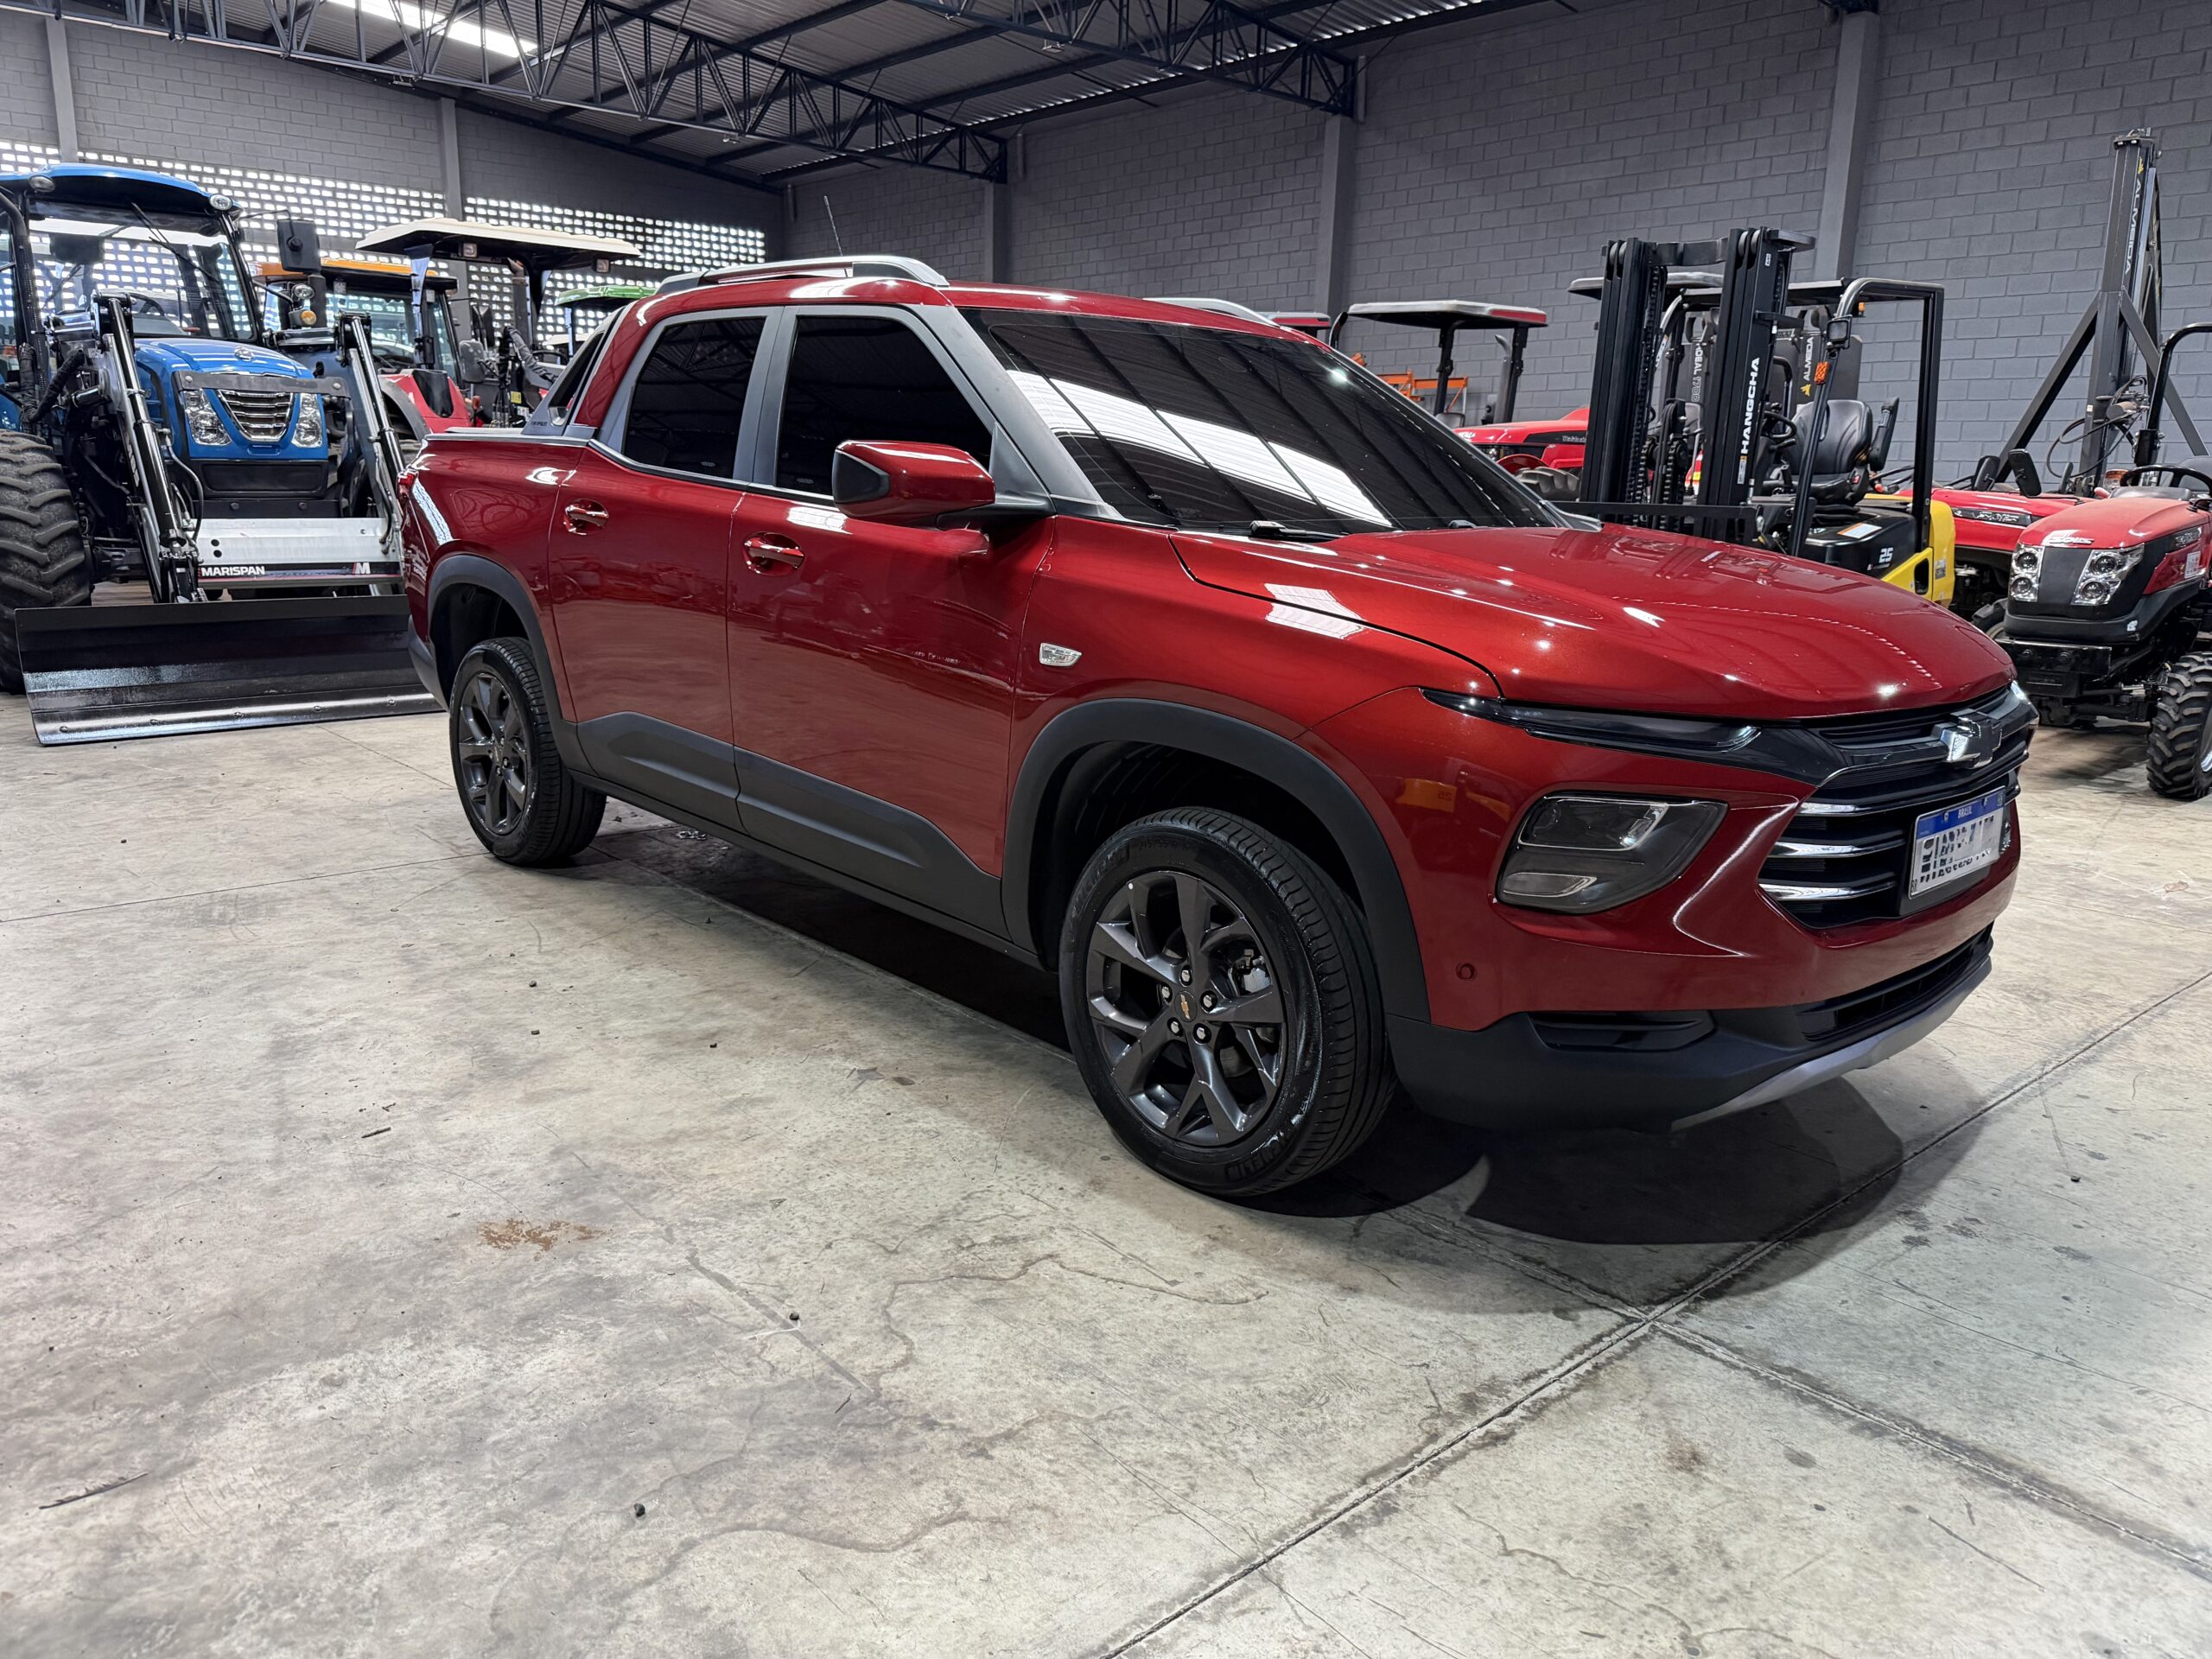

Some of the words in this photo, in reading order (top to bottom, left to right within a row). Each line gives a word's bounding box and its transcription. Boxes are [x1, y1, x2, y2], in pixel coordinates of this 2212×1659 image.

[2125, 179, 2142, 275] ALMEIDA
[1803, 336, 1815, 381] ALMEIDA
[1692, 376, 1702, 402] 1700
[1741, 357, 1760, 454] HANGCHA
[1878, 547, 1893, 563] 25
[200, 565, 265, 576] MARISPAN
[1958, 805, 1972, 818] BRASIL
